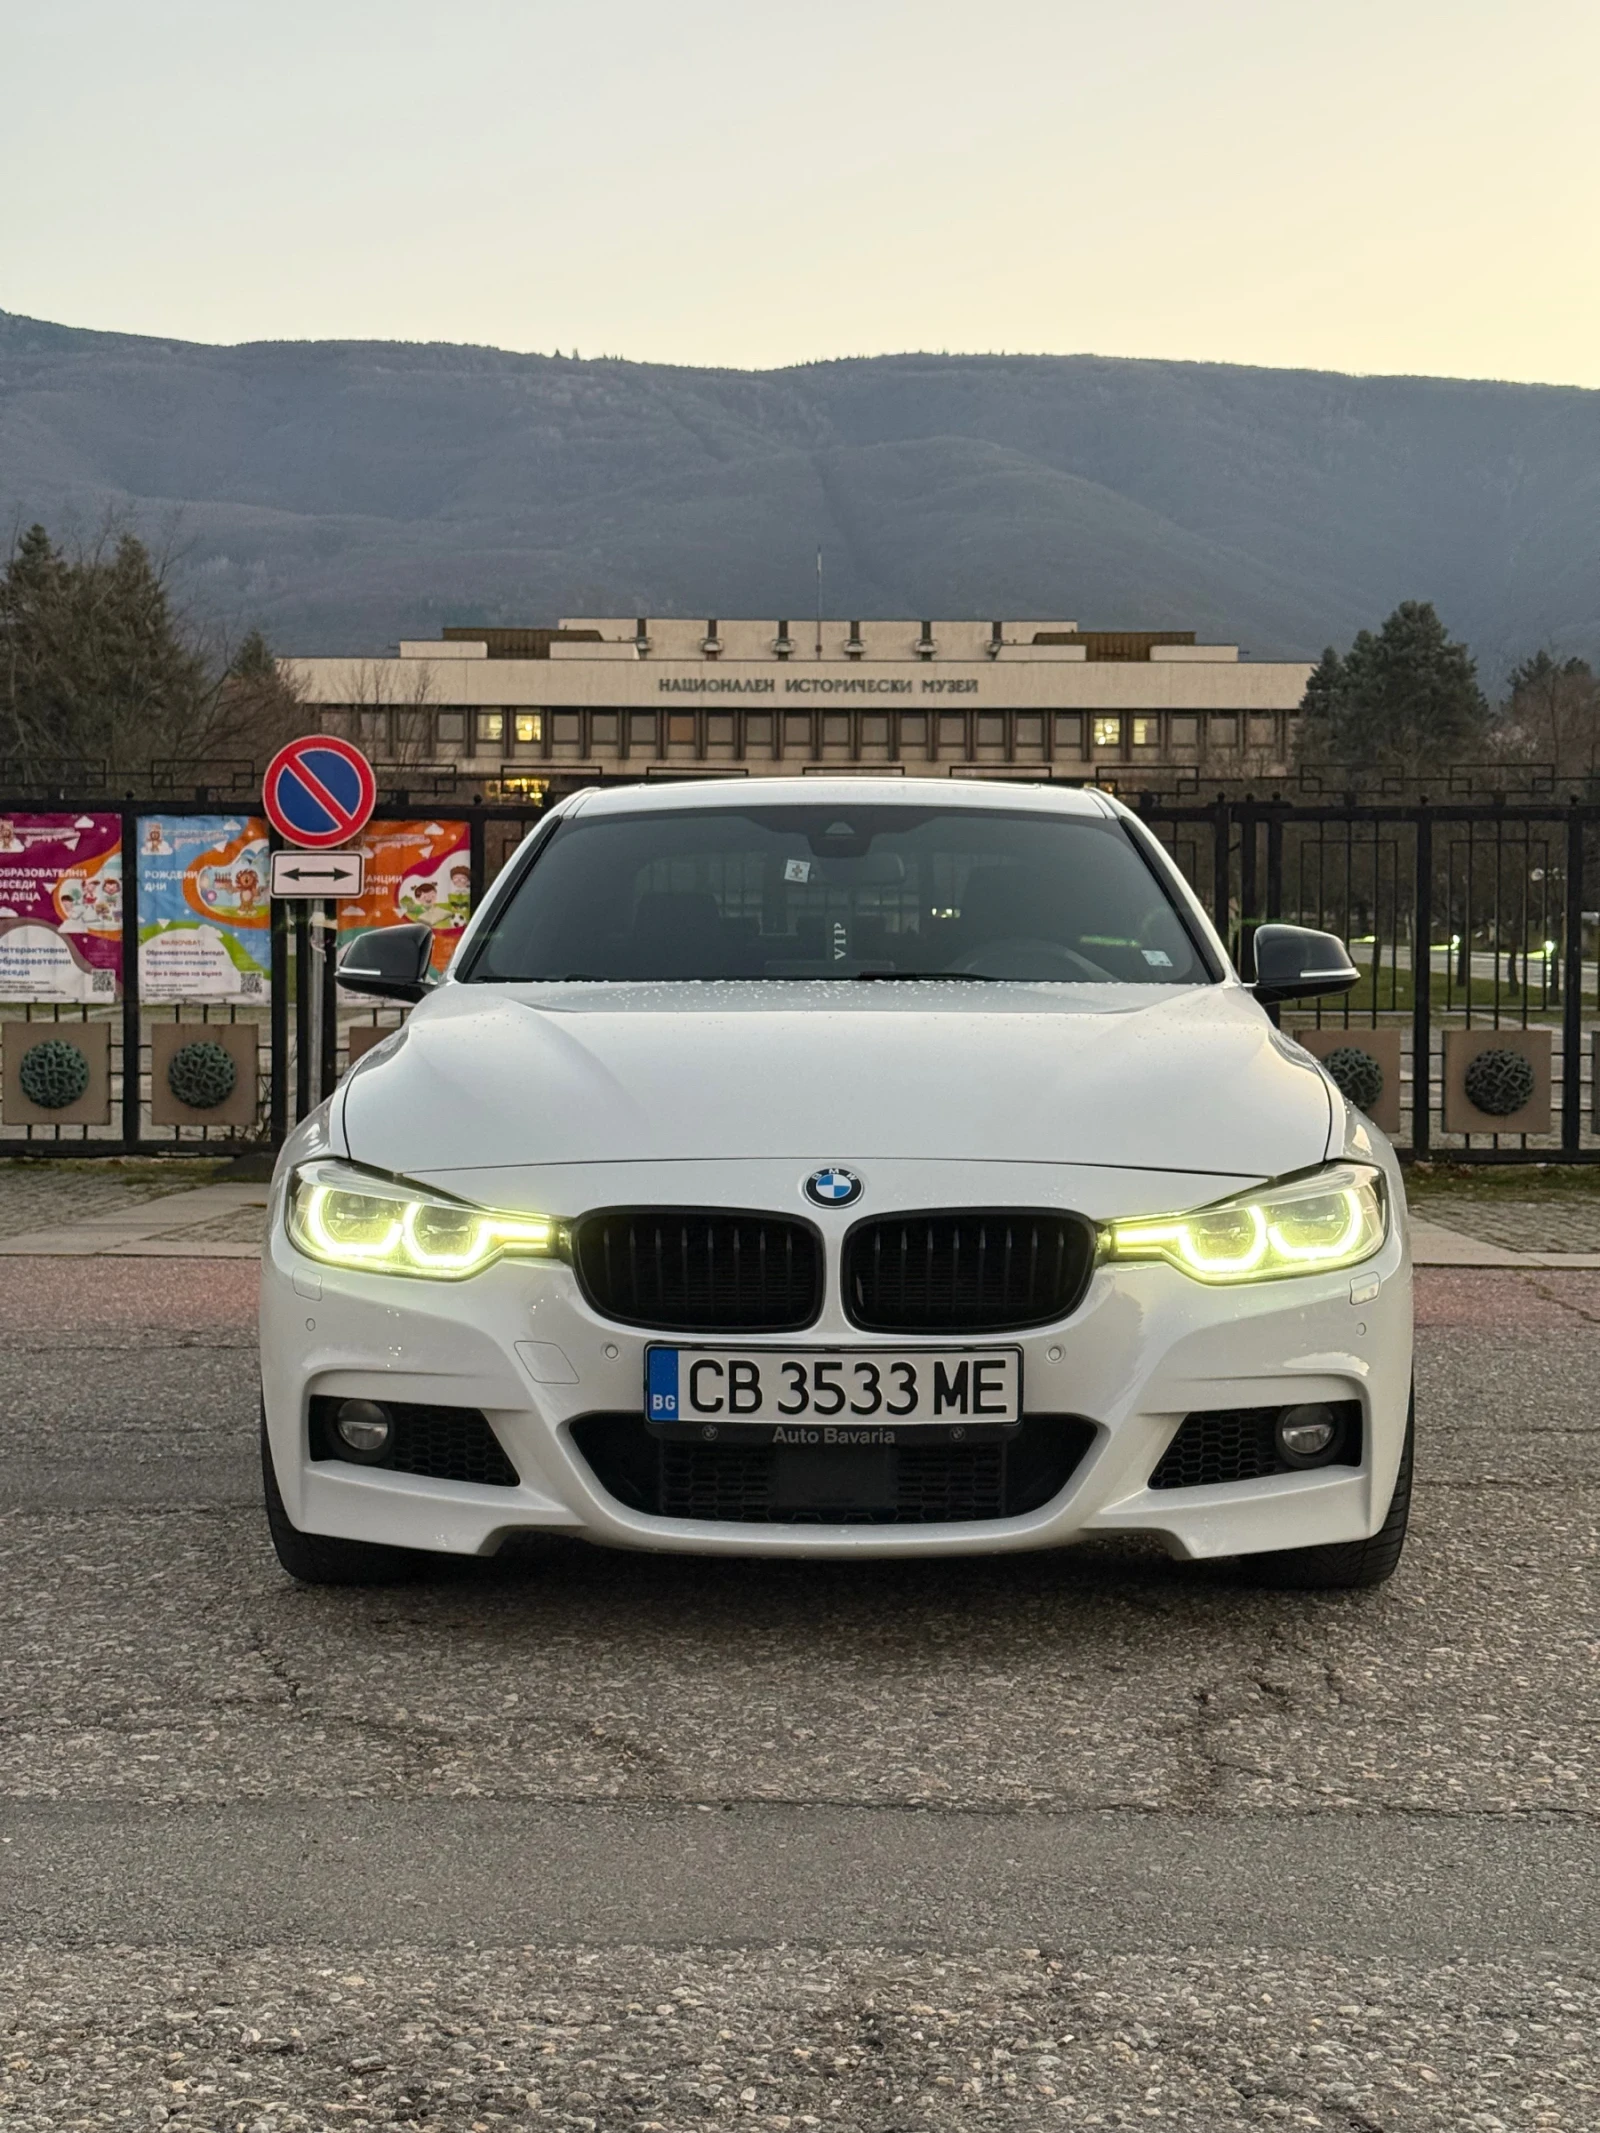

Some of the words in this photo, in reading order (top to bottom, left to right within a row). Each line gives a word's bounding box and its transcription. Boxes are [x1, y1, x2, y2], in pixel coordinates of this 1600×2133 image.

[658, 678, 775, 693] НАЦИОНАЛЕН
[785, 678, 912, 693] ИСТОРИЧЕСКИ
[921, 678, 979, 693] МУЗЕЙ
[144, 870, 199, 880] РОЖДЕНИ
[365, 874, 402, 885] АНЦИИ
[144, 882, 167, 892] ДНИ
[11, 891, 41, 903] ДЕЦА
[833, 922, 846, 960] VIP
[811, 1168, 859, 1181] BMW
[689, 1358, 763, 1414] CB
[777, 1361, 919, 1415] 3533
[933, 1360, 1007, 1415] ME
[653, 1394, 676, 1411] BG
[772, 1426, 819, 1444] Auto
[823, 1427, 896, 1445] Bavaria
